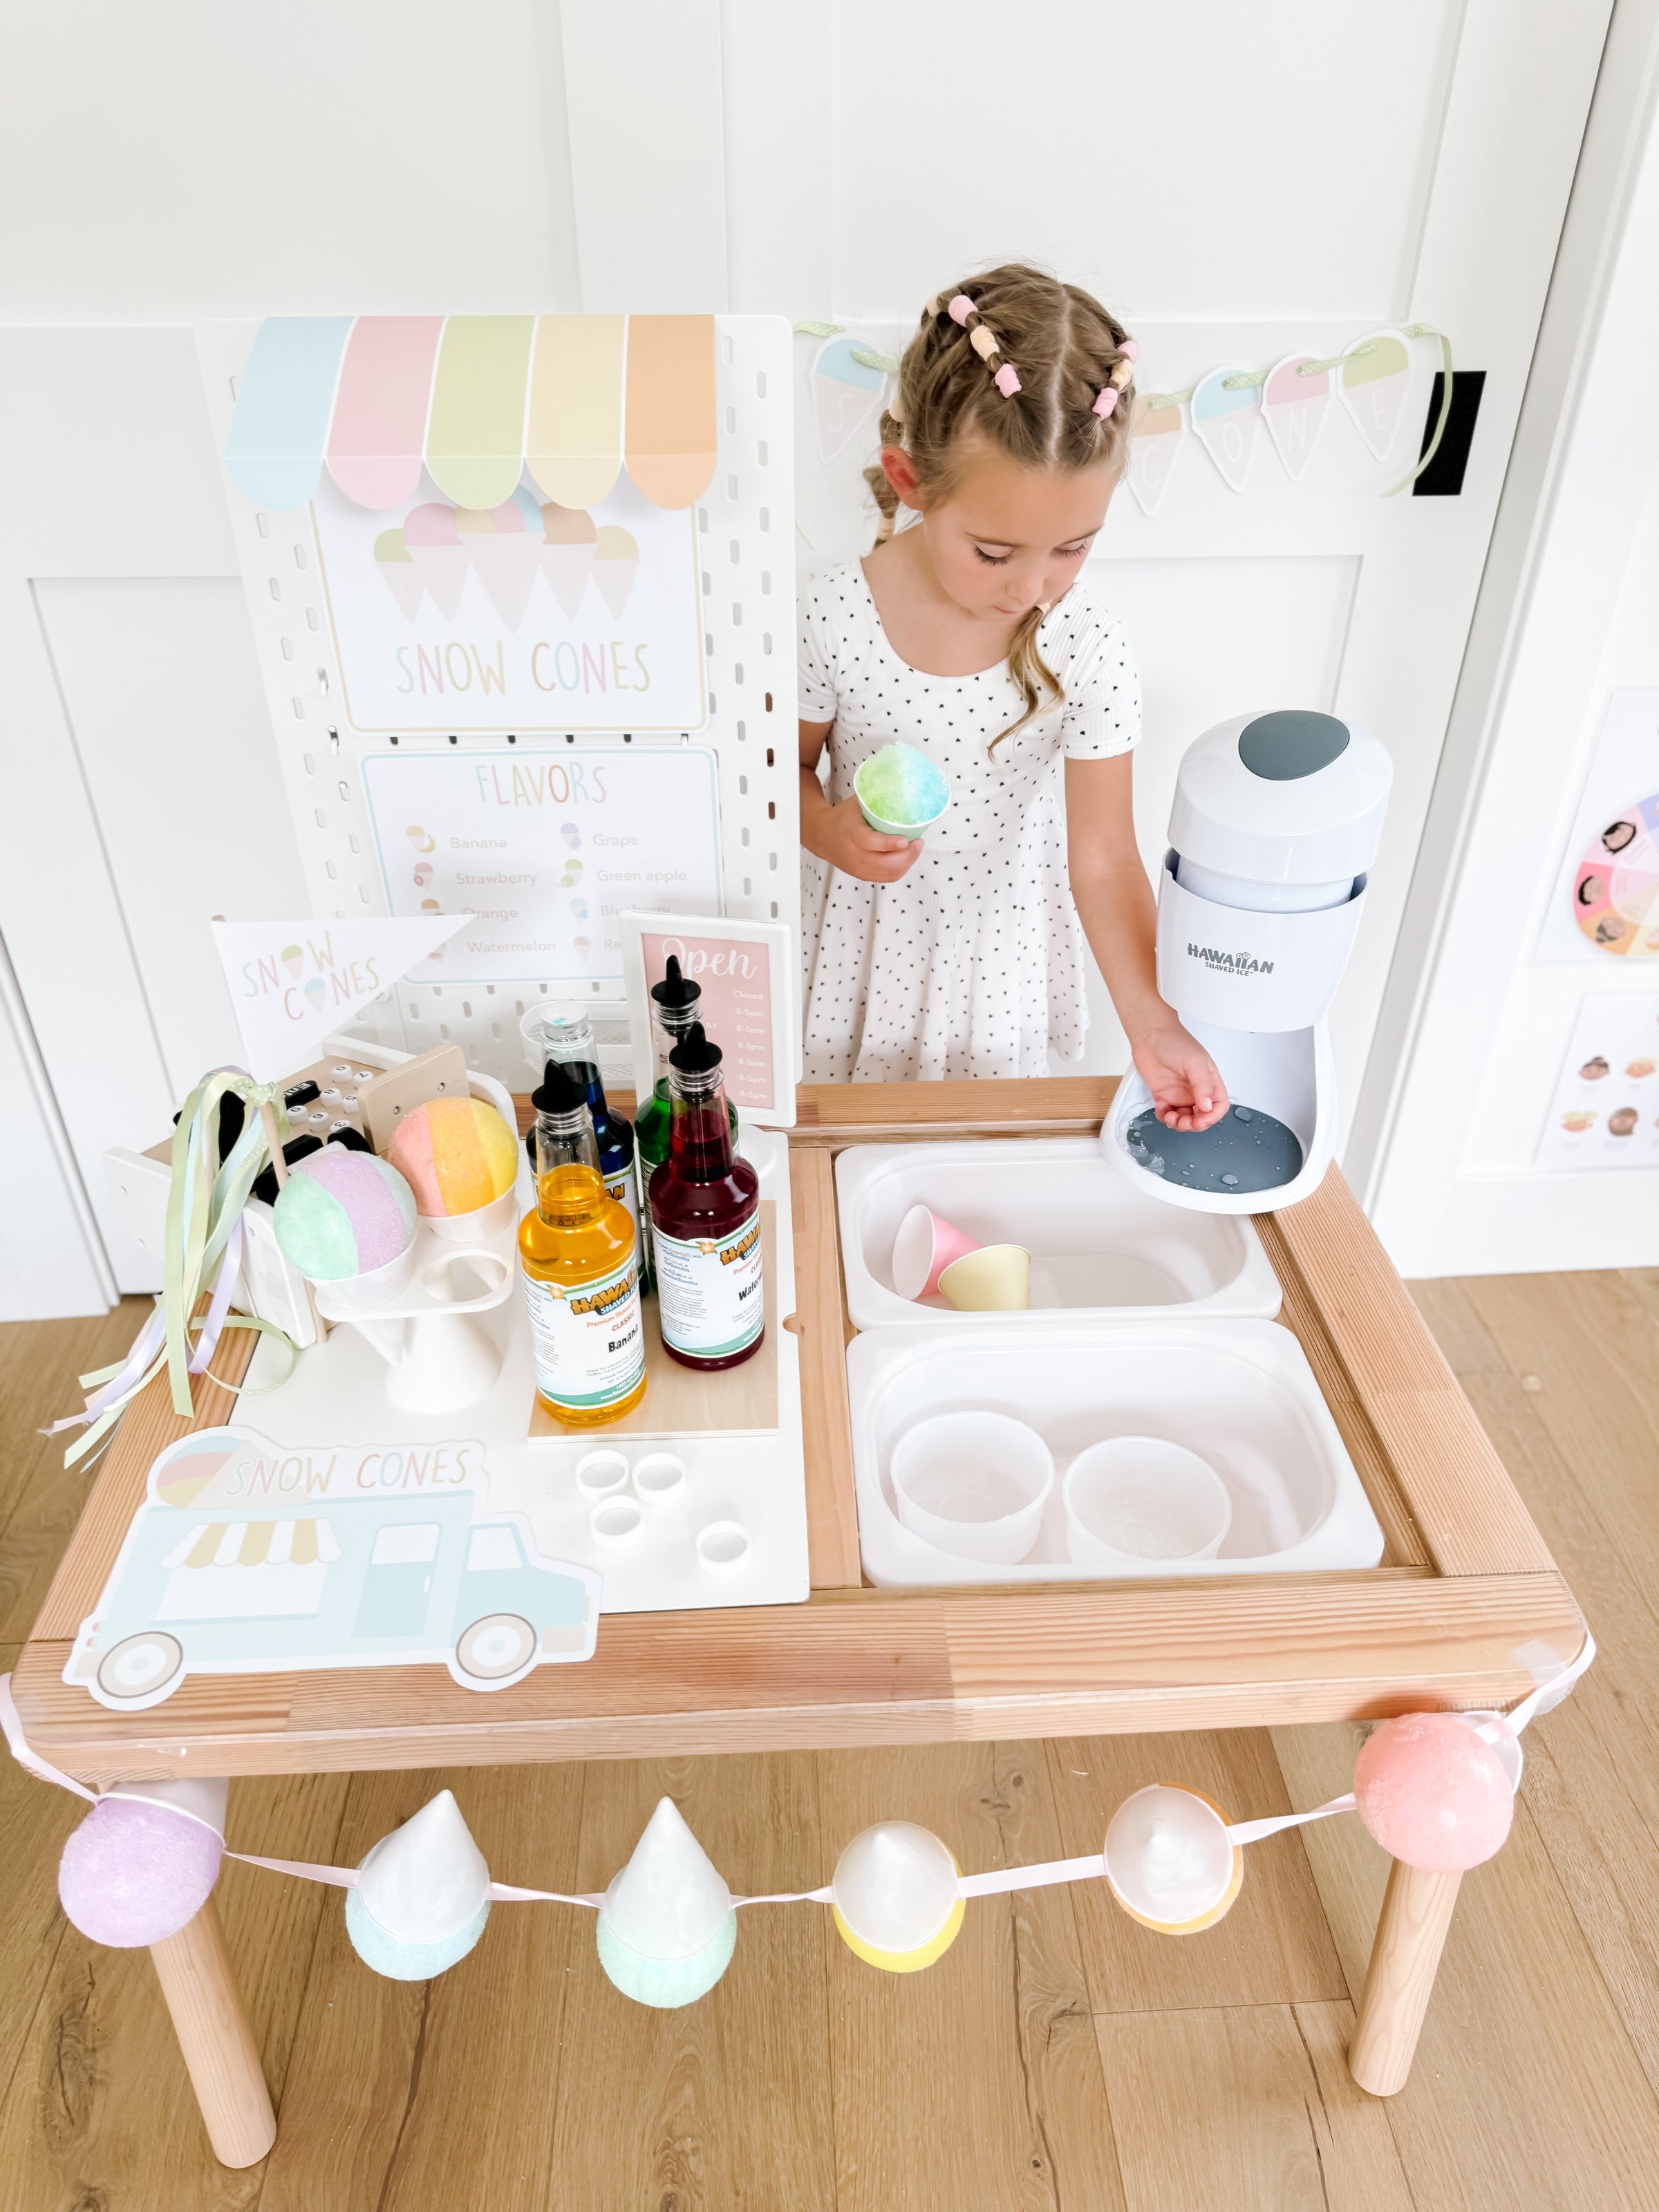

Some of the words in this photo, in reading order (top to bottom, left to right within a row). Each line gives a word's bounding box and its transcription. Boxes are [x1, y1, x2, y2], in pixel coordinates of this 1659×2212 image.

[395, 640, 507, 695] SNOW
[530, 641, 650, 695] CONES
[475, 760, 608, 807] FLAVORS
[449, 836, 507, 849] Banana
[593, 834, 639, 849] Grape
[456, 872, 537, 885] Strawberry
[597, 870, 641, 882] Green
[646, 869, 687, 883] apple
[467, 940, 556, 953] Watermelon
[662, 937, 757, 980] Open
[1187, 942, 1275, 974] HAWAIIAN
[1205, 962, 1235, 973] SHAVED
[733, 991, 764, 1000] Closed
[735, 1008, 764, 1018] 8-5pm
[736, 1024, 765, 1034] 8-5pm
[737, 1041, 765, 1051] 8-5pm
[738, 1058, 766, 1067] 8-5pm
[739, 1074, 767, 1084] 8-5pm
[283, 1083, 311, 1097] Ent
[740, 1090, 767, 1100] 8-5pm
[600, 1291, 630, 1315] SHAVED
[225, 1453, 337, 1497] SNOW
[357, 1449, 471, 1490] CONES
